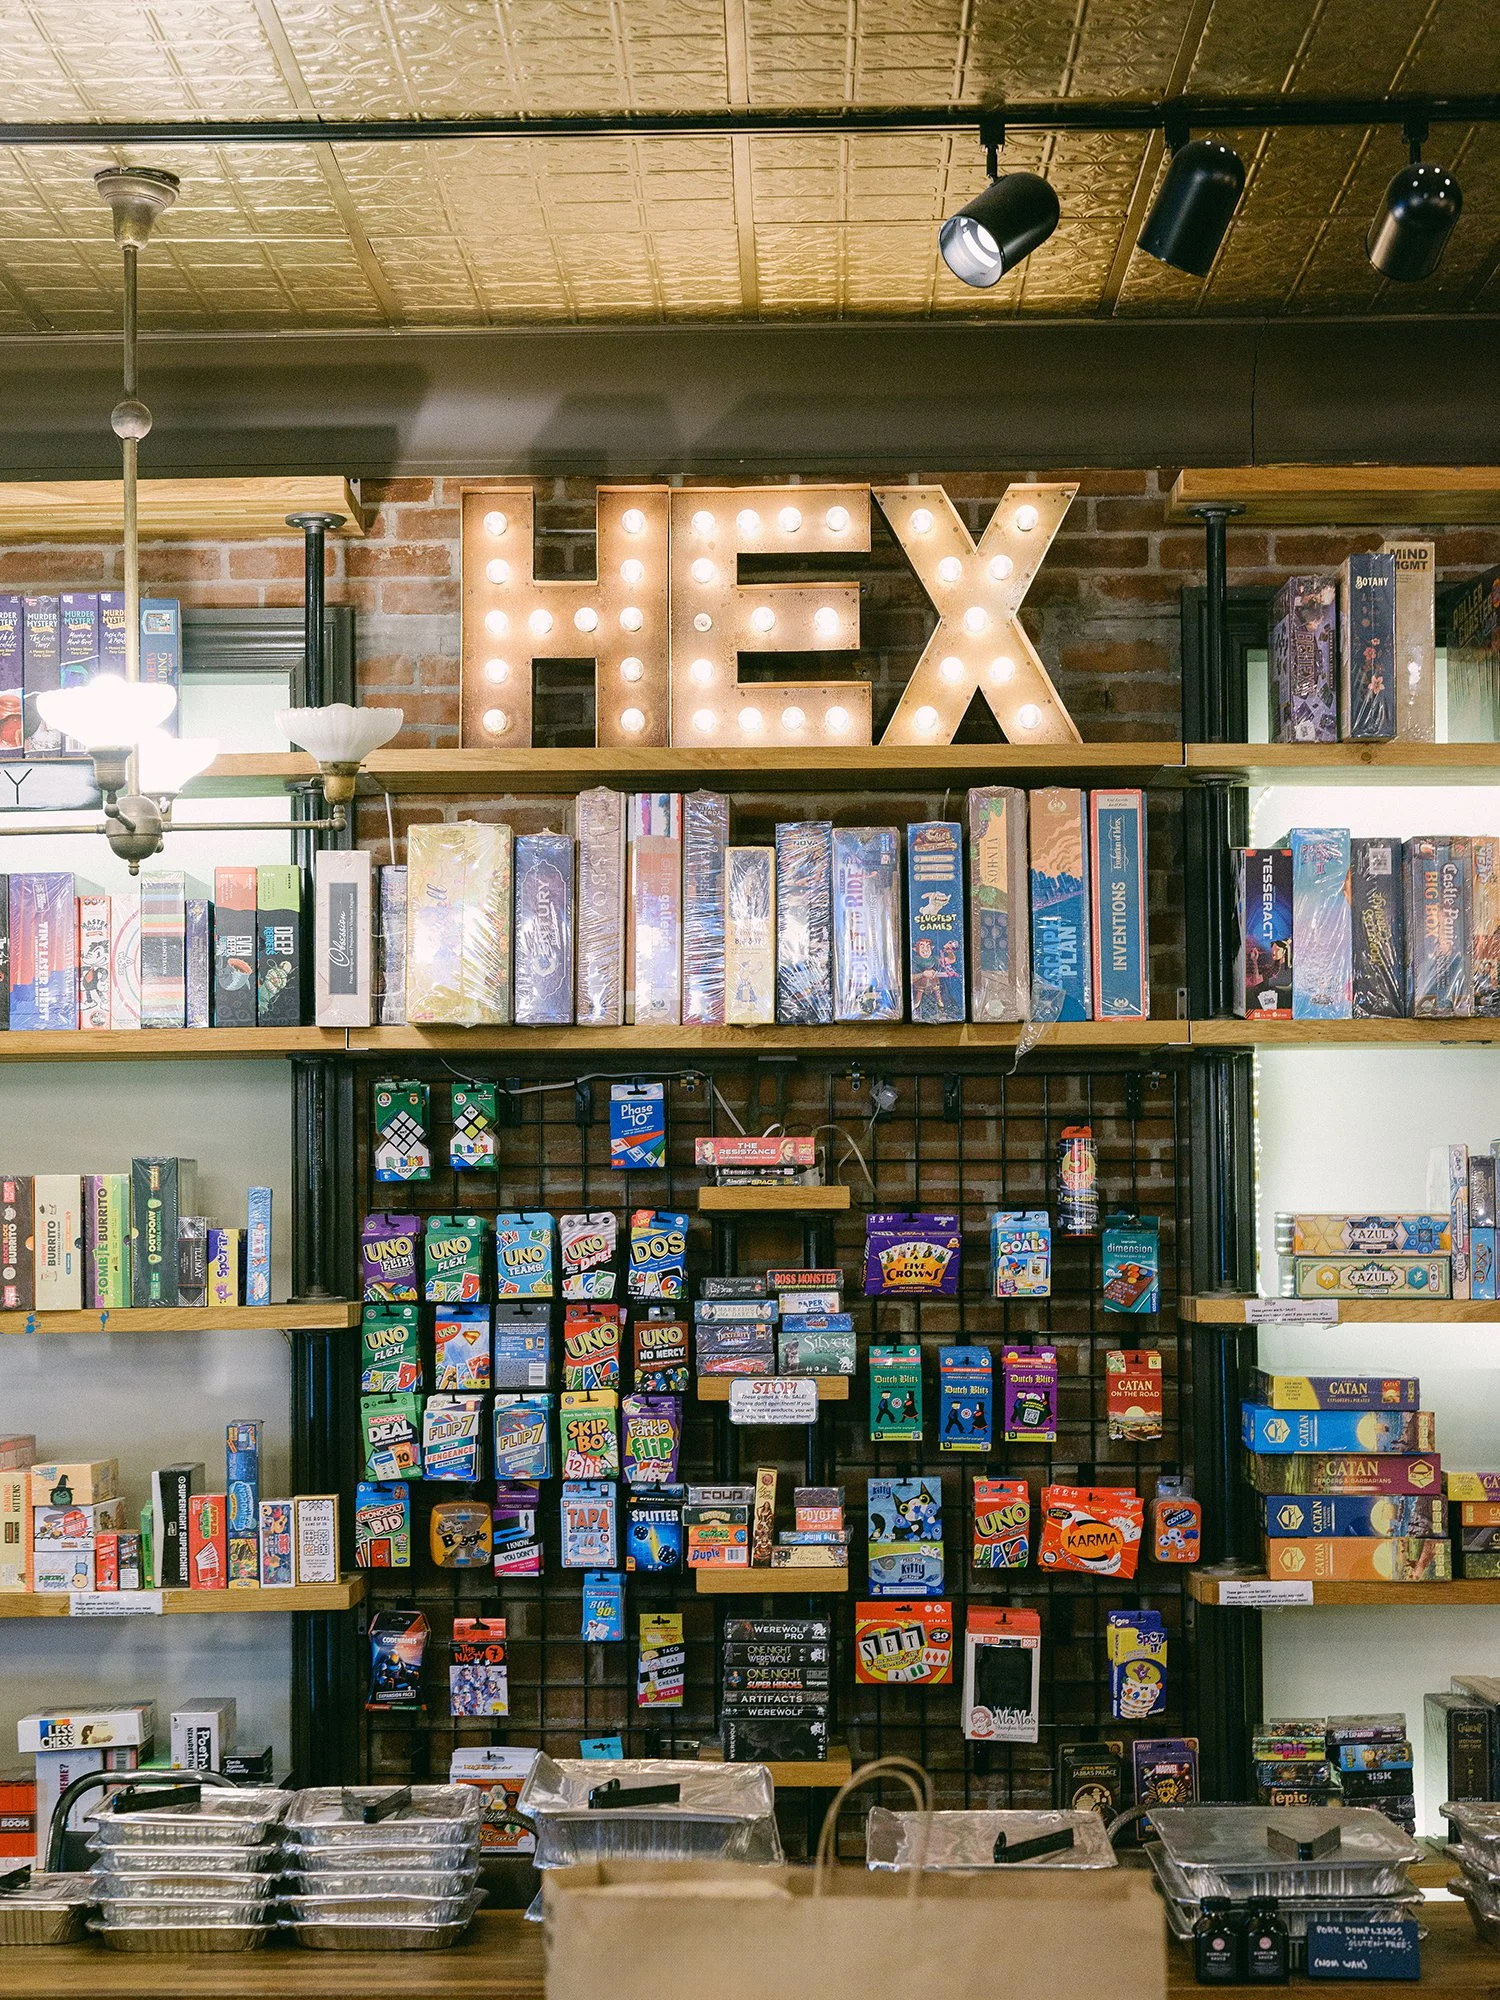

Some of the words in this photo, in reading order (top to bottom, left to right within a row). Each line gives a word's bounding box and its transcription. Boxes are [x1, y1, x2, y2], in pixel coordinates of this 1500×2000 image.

[1356, 576, 1388, 589] BOTANY
[26, 620, 58, 628] MYSTERY
[460, 483, 1084, 749] HEX
[845, 868, 864, 908] RIDE
[1424, 871, 1438, 900] BIG
[1442, 864, 1458, 904] Castle
[1262, 855, 1273, 940] TESSERACT
[82, 918, 108, 930] MASTER
[914, 913, 957, 924] SLUGFEST
[1112, 882, 1127, 971] INVENTIONS
[1425, 904, 1439, 938] BOX
[38, 922, 48, 948] TINY
[920, 922, 952, 932] GAMES
[236, 936, 252, 956] EVEN
[264, 926, 274, 956] REGRETS
[274, 926, 294, 954] DEEP
[328, 910, 350, 966] Obsession
[1058, 926, 1077, 976] PLAN
[38, 948, 49, 989] LASER
[38, 990, 50, 1021] HEIST
[621, 1104, 653, 1118] Phase
[630, 1114, 648, 1126] 10
[98, 1188, 108, 1241] BURRITO
[148, 1210, 156, 1252] AVOCADO
[1358, 1230, 1388, 1238] AZUL
[9, 1224, 17, 1264] BURRITO
[48, 1220, 56, 1266] BURRITO
[364, 1238, 413, 1263] UNO
[430, 1237, 472, 1260] UNO
[568, 1238, 606, 1260] UNO
[632, 1232, 686, 1266] DOS
[1000, 1239, 1048, 1254] GOALS
[1108, 1243, 1152, 1253] dimension
[382, 1256, 414, 1272] FLIP!
[438, 1256, 467, 1272] FLEX!
[504, 1247, 545, 1266] UNO
[580, 1250, 612, 1271] DARE!
[98, 1244, 108, 1296] ZOMBIE
[508, 1264, 544, 1276] TEAMS!
[886, 1268, 941, 1282] CROWNS
[1358, 1273, 1388, 1282] AZUL
[775, 1274, 796, 1284] BOSS
[797, 1274, 836, 1284] MONSTER
[366, 1326, 408, 1349] UNO
[438, 1326, 458, 1338] UNO
[640, 1327, 682, 1348] UNO
[566, 1324, 618, 1360] UNO
[374, 1345, 404, 1362] FLEX!
[640, 1350, 653, 1360] NO
[874, 1375, 898, 1384] Dutch
[900, 1375, 919, 1384] Blitz
[1010, 1374, 1033, 1383] Dutch
[1035, 1374, 1054, 1384] Blitz
[1118, 1380, 1152, 1390] CATAN
[752, 1382, 797, 1394] STOP!
[944, 1386, 968, 1394] Dutch
[970, 1386, 989, 1394] Blitz
[1329, 1382, 1368, 1394] CATAN
[369, 1414, 405, 1424] MONOPOLY
[429, 1425, 458, 1440] FLIP
[461, 1414, 476, 1436] 7
[368, 1421, 412, 1442] DEAL
[500, 1435, 532, 1450] FLIP
[532, 1423, 545, 1444] 7
[628, 1420, 668, 1437] Farkle
[1300, 1414, 1308, 1447] CATAN
[577, 1434, 605, 1453] BO
[632, 1438, 674, 1462] flip
[397, 1452, 409, 1463] 10
[427, 1446, 474, 1462] VENGEANCE
[569, 1460, 580, 1472] 12
[1326, 1461, 1379, 1476] CATAN
[178, 1484, 187, 1527] SUPERFIGHT
[360, 1503, 404, 1521] MONOPOLY
[632, 1510, 678, 1522] SPLITTER
[799, 1510, 838, 1520] COYOTE
[976, 1502, 1030, 1538] UNO
[1166, 1510, 1190, 1526] CENTER
[1313, 1500, 1322, 1533] CATAN
[370, 1517, 404, 1535] BID
[442, 1530, 488, 1548] Boggle
[180, 1528, 188, 1582] SUPERCHEST
[502, 1554, 516, 1562] YOU
[518, 1550, 535, 1560] DON'T
[692, 1549, 720, 1560] Duple
[1315, 1543, 1324, 1576] CATAN
[596, 1608, 616, 1616] 90's
[382, 1636, 417, 1645] CODENAMES
[460, 1644, 476, 1653] THE
[455, 1652, 484, 1662] NASTY
[662, 1646, 680, 1654] TACO
[662, 1667, 680, 1676] GOAT
[746, 1669, 769, 1678] ONE
[772, 1669, 800, 1678] NIGHT
[658, 1678, 680, 1687] CHEESE
[48, 1724, 74, 1736] LESS
[41, 1736, 74, 1748] CHESS
[1155, 1764, 1180, 1774] MARVEL
[1, 1818, 30, 1827] BOOM
[1316, 1926, 1342, 1934] PORK
